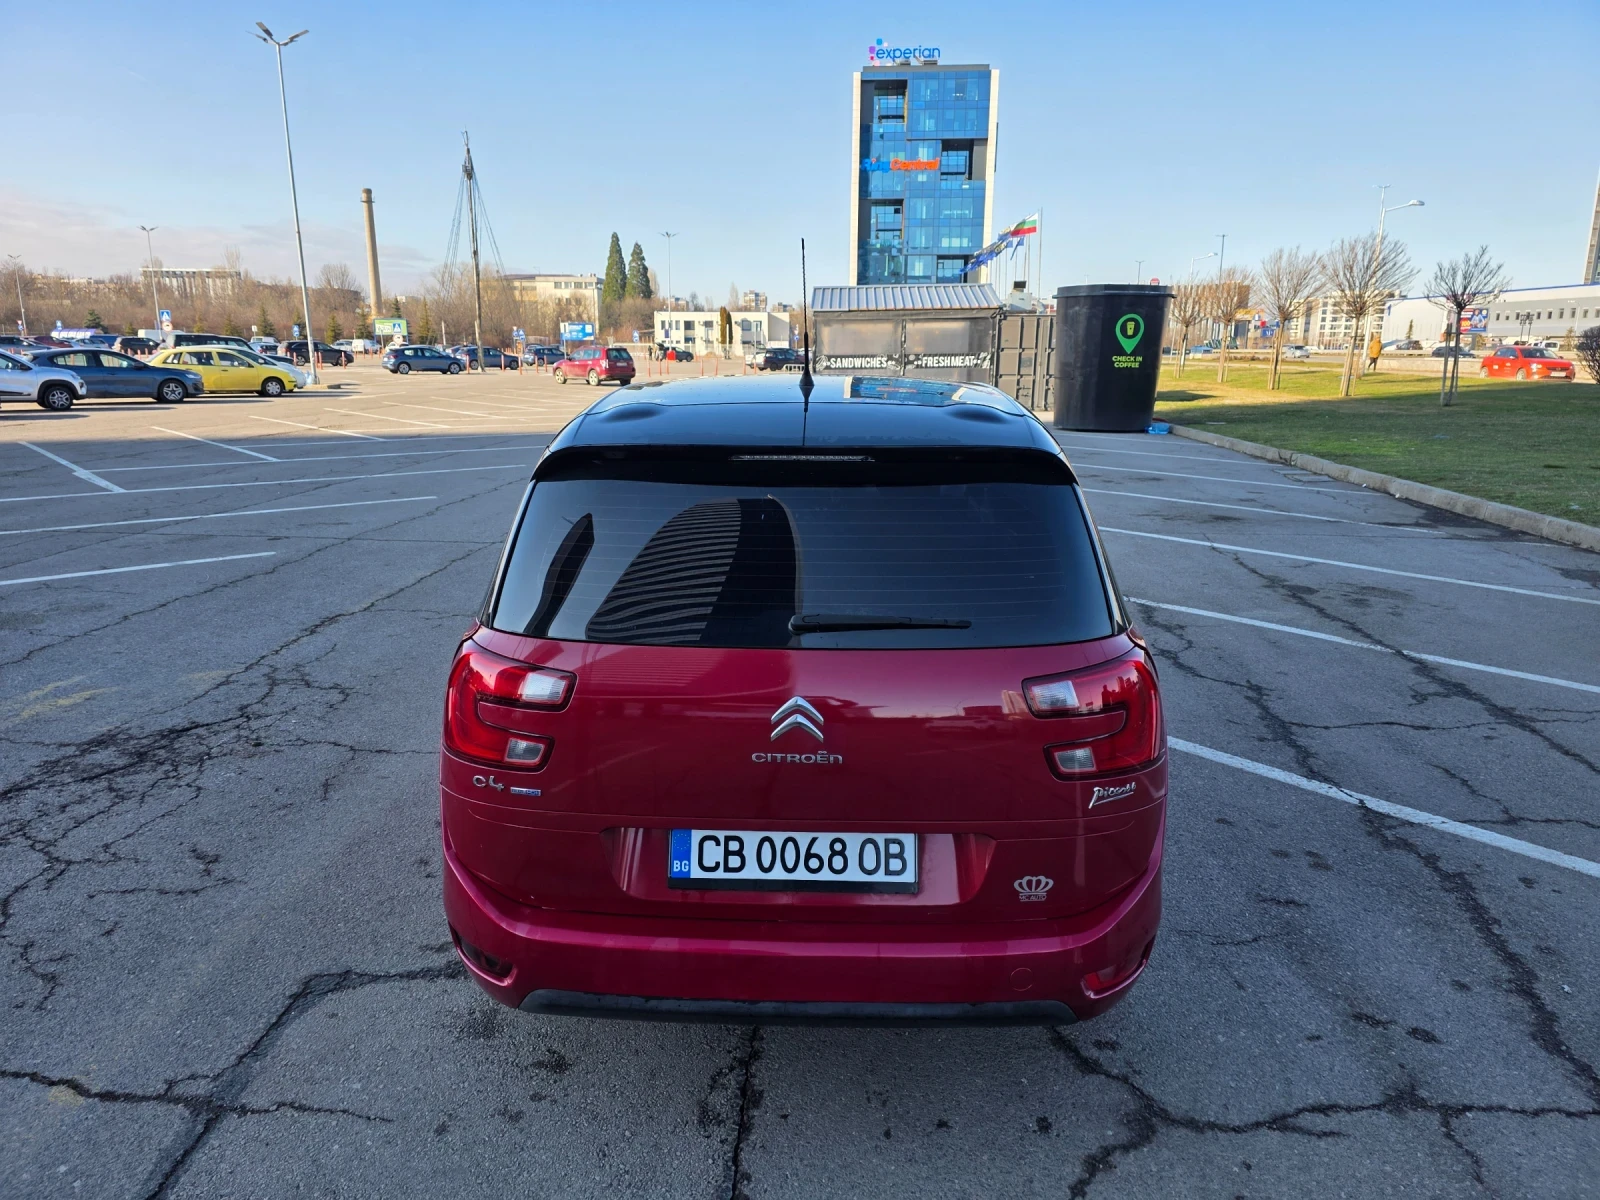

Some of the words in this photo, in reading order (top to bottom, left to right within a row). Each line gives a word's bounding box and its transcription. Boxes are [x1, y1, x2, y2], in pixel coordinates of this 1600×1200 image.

[876, 45, 940, 63] experian
[861, 157, 940, 173] RingCentral
[830, 357, 888, 368] SANDWICHES
[472, 775, 505, 792] C4
[1088, 781, 1137, 809] Picasso
[697, 834, 746, 873] CB
[756, 835, 849, 875] 0068
[858, 837, 908, 876] OB
[673, 860, 689, 872] BG
